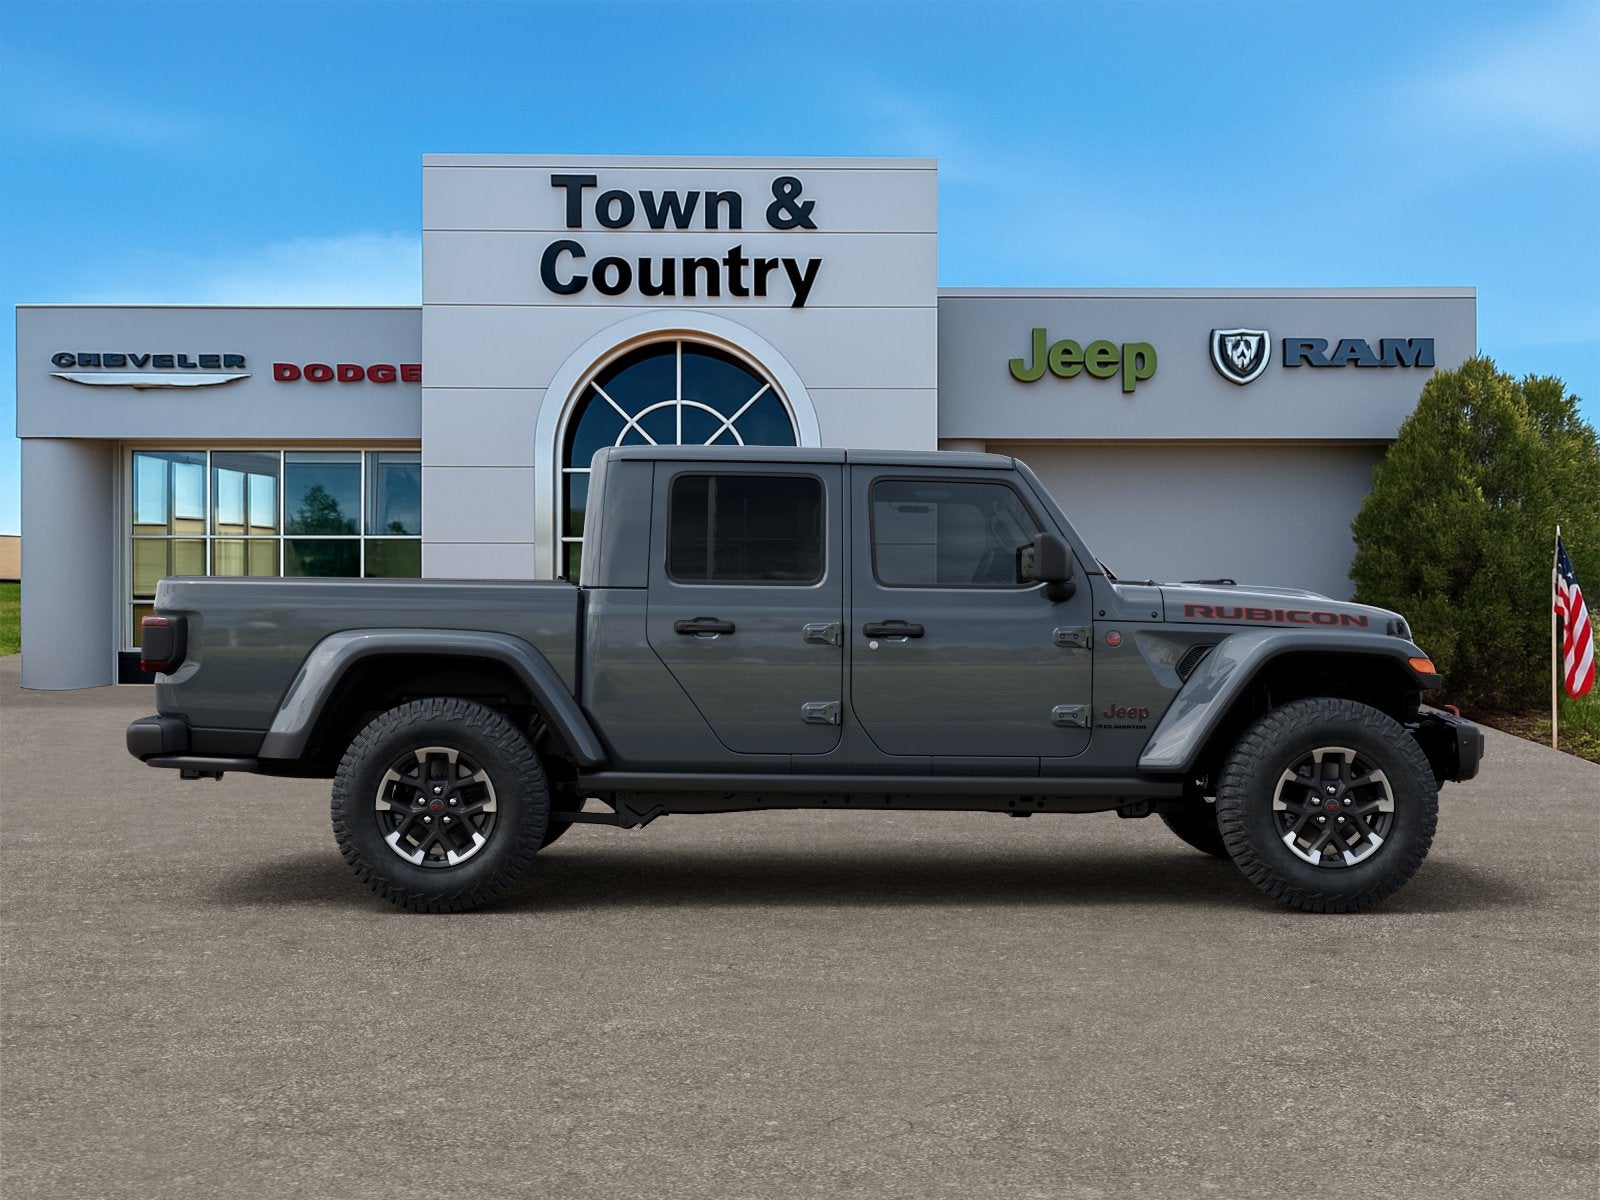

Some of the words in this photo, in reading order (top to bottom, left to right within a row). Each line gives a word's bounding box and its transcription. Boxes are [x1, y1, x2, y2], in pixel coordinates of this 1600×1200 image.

[550, 173, 743, 229] Town
[765, 175, 818, 230] &
[539, 239, 823, 309] Country
[1009, 327, 1158, 393] Jeep
[1283, 337, 1436, 368] RAM
[272, 362, 422, 383] DODGE
[1184, 604, 1368, 628] RUBICON
[1103, 703, 1150, 722] Jeep
